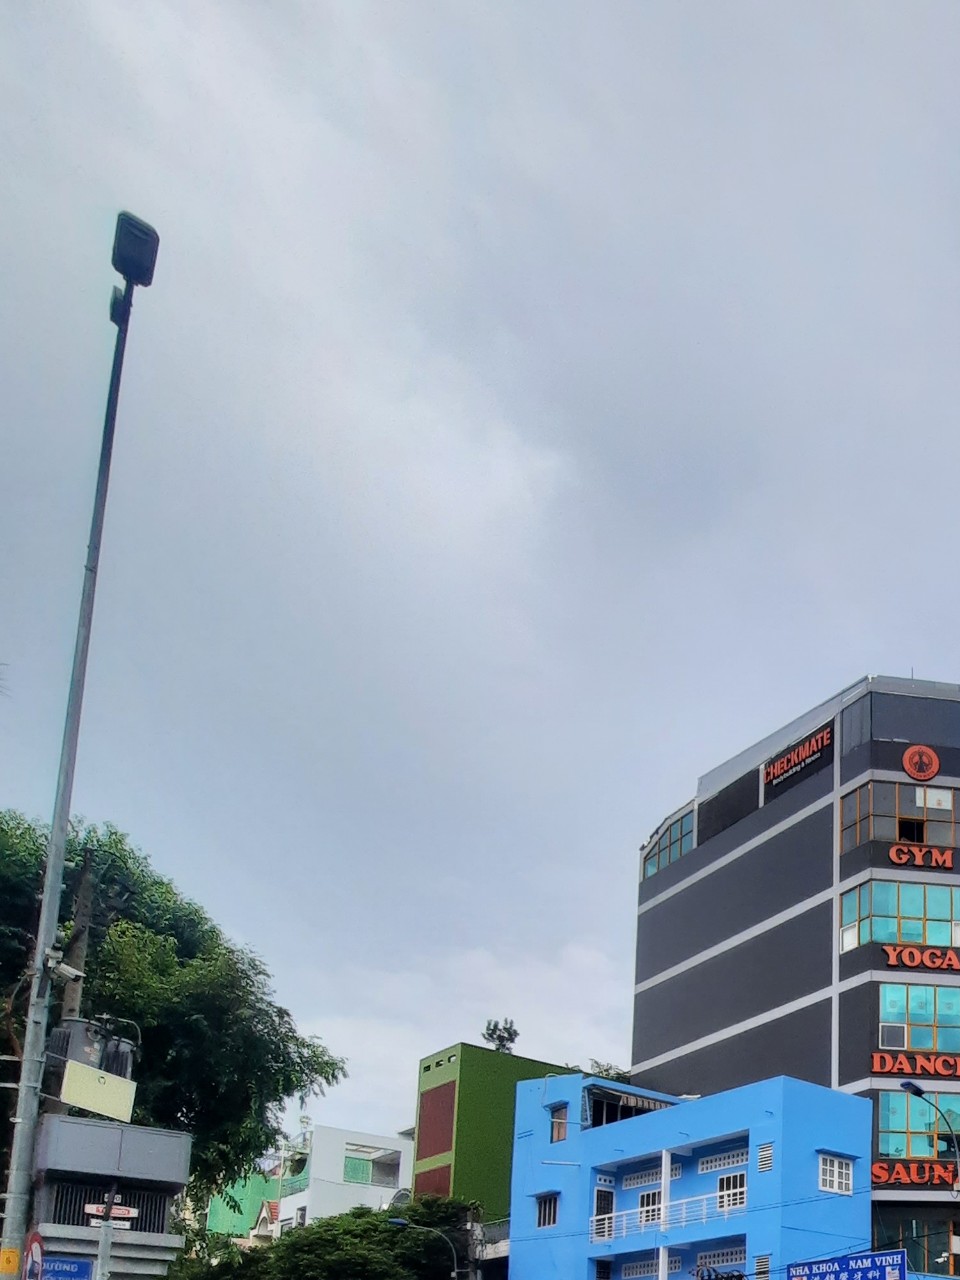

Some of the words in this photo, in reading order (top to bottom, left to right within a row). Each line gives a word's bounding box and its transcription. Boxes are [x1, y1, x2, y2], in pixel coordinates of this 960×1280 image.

[764, 727, 831, 784] CHECKMATE
[888, 845, 954, 869] GYM
[789, 1265, 810, 1276] NHA
[812, 1262, 840, 1274] KHOA
[849, 1257, 872, 1269] NAM
[874, 1254, 902, 1266] VINH
